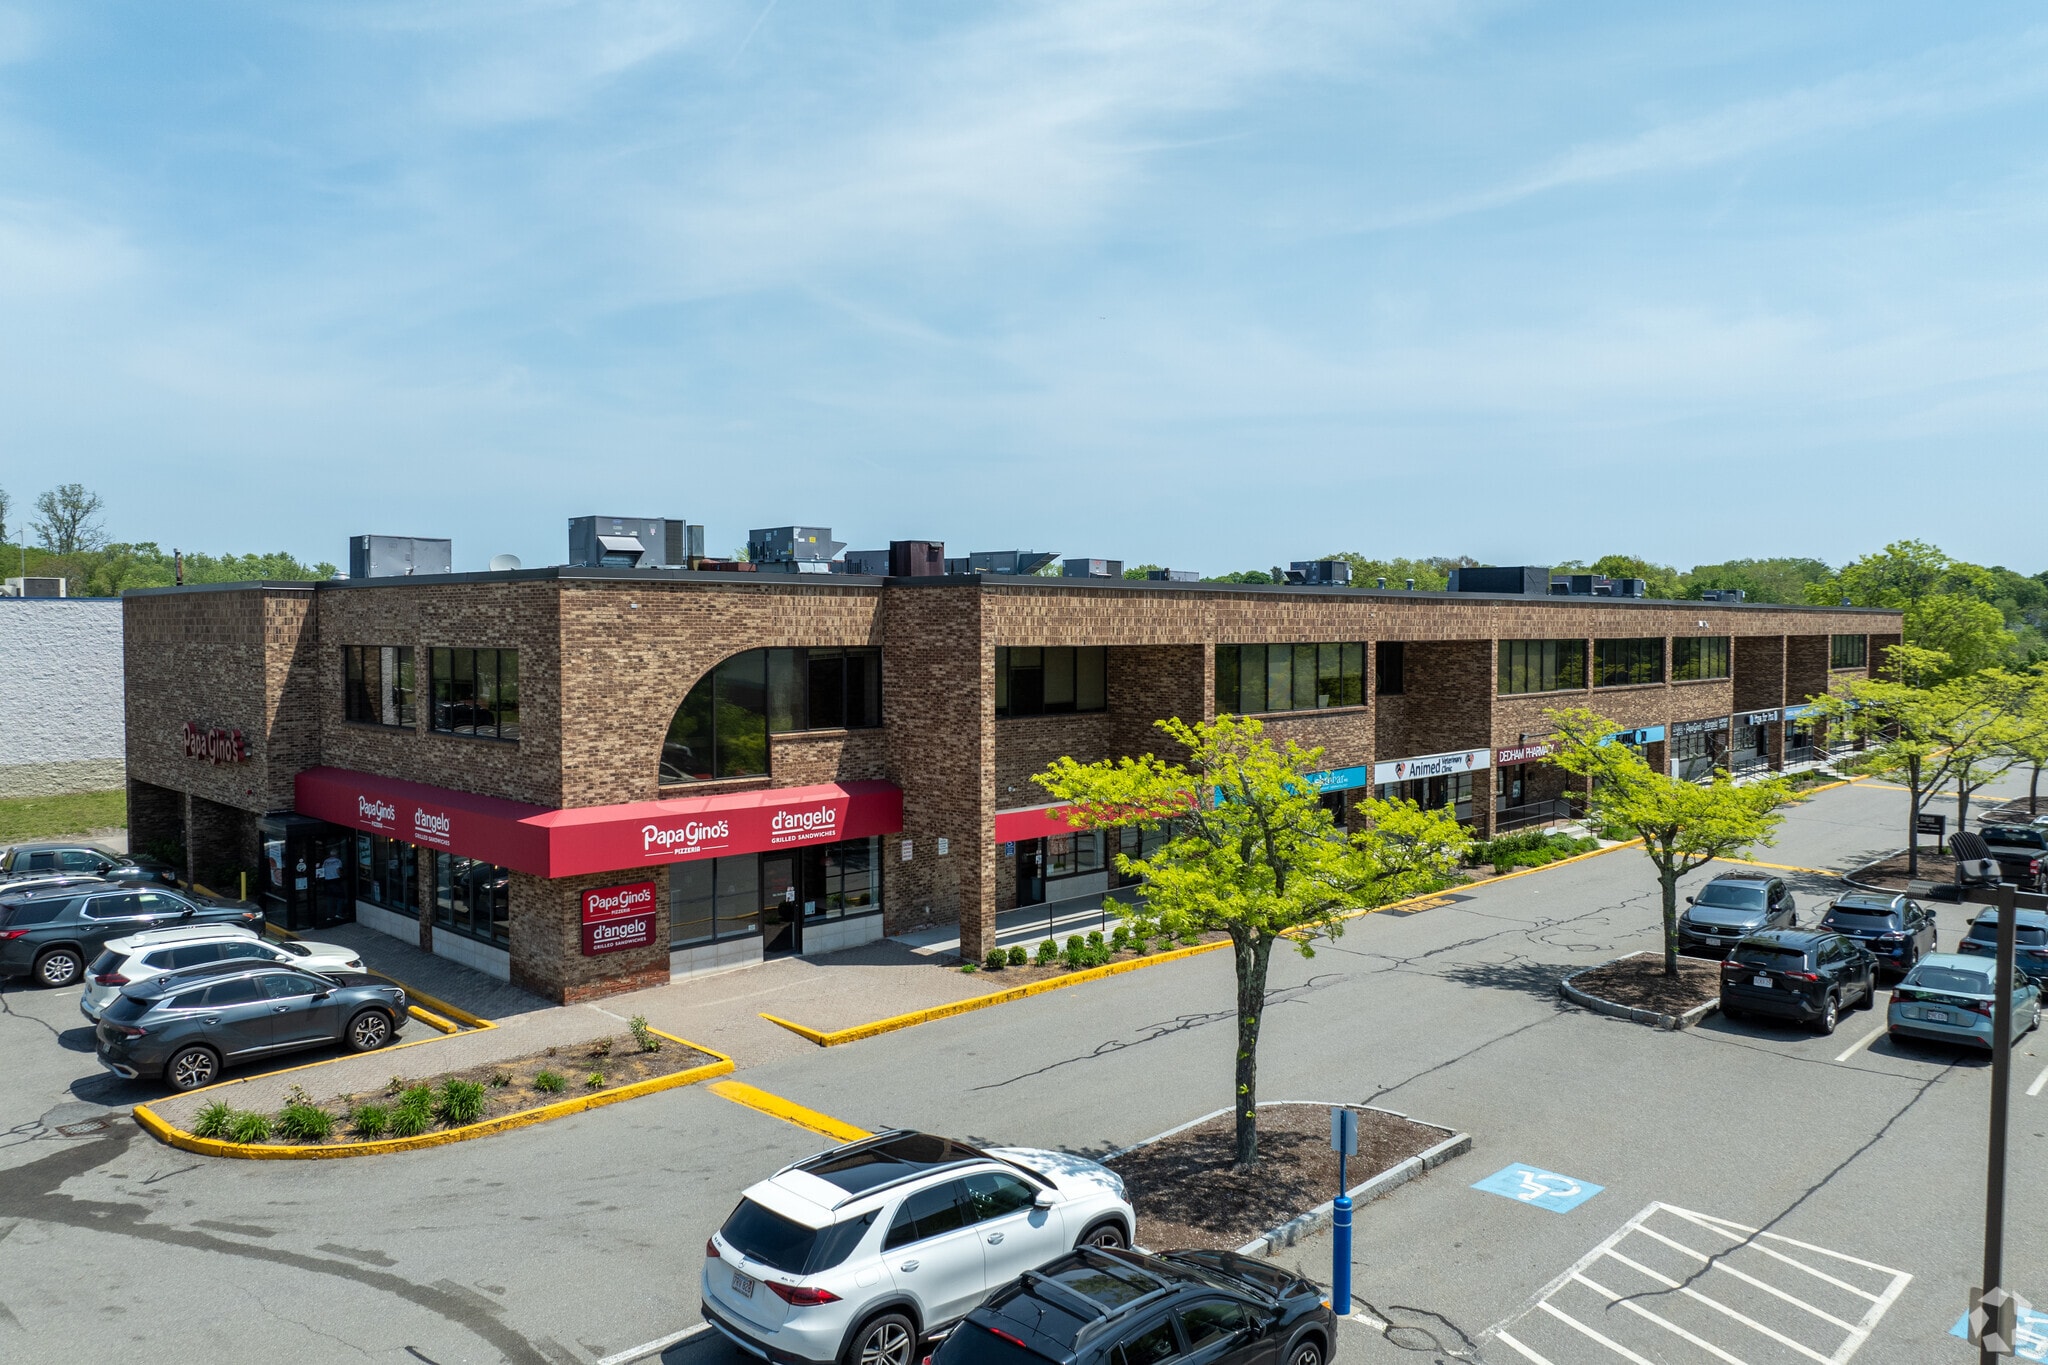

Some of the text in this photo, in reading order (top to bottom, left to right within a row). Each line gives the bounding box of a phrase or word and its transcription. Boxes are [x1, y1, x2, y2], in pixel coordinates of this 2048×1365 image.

[183, 722, 207, 761] Papa
[1499, 748, 1525, 763] DEDHAM
[1409, 758, 1441, 777] Animed
[1441, 765, 1453, 774] Clinic
[358, 795, 376, 819] Papa
[771, 805, 836, 830] d'angelo
[414, 807, 450, 833] d'angelo
[641, 819, 729, 851] Papa Gino's
[771, 830, 836, 844] GRILLED SANDWICHES
[674, 846, 701, 855] PIZZERIA
[587, 888, 652, 913] Papa Gino's
[593, 919, 647, 940] d'angelo
[592, 936, 647, 950] GRILLED SANDWICHES
